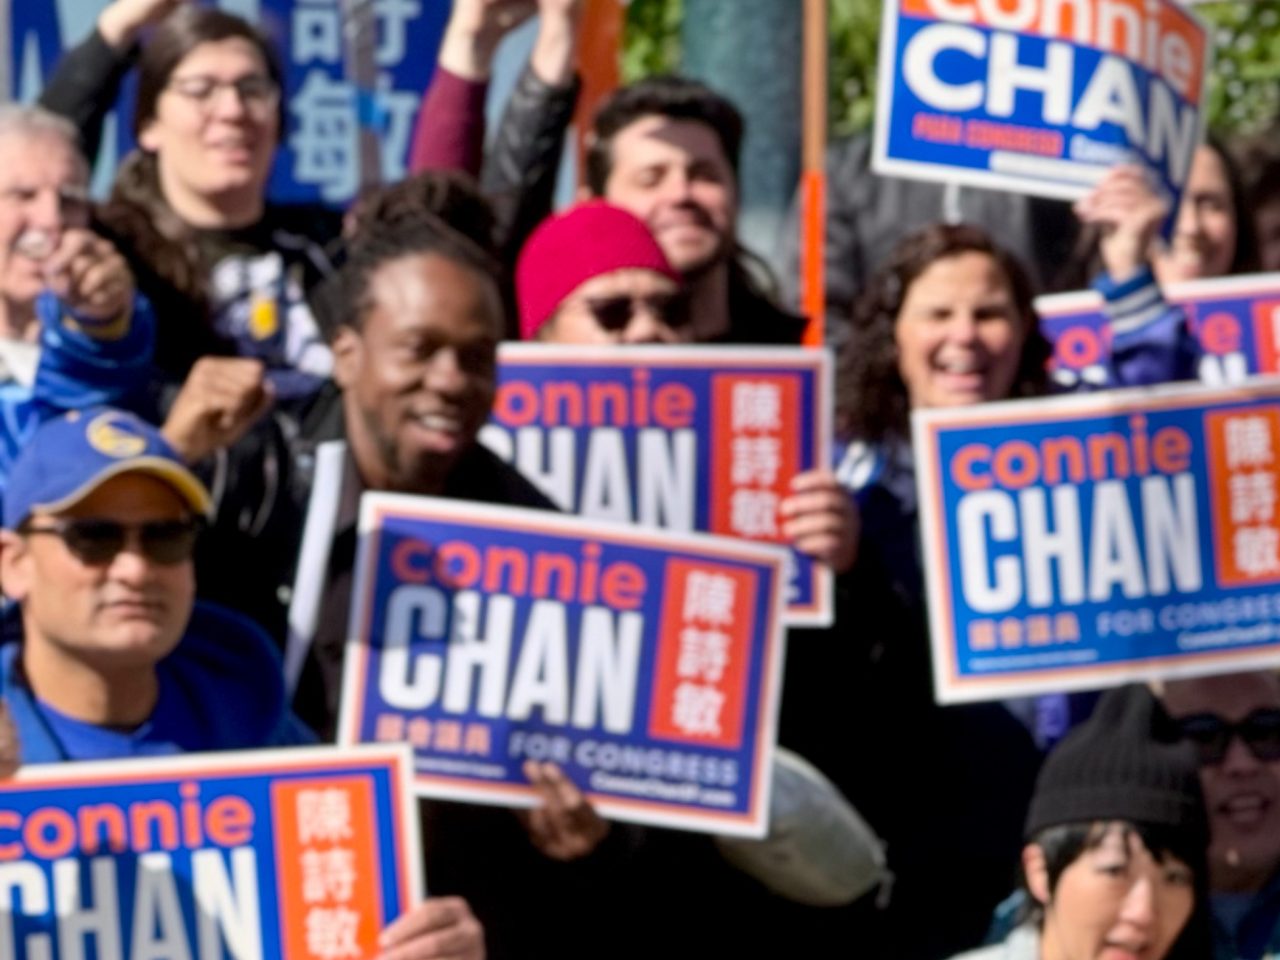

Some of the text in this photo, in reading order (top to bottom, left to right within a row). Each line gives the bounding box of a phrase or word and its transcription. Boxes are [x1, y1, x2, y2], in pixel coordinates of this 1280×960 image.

[902, 20, 1198, 188] CHAN
[492, 367, 696, 428] onnie
[951, 414, 1192, 491] connie
[391, 540, 647, 610] connie
[957, 473, 1203, 613] CHAN
[379, 584, 643, 735] CHAN
[1096, 608, 1156, 638] FOR
[508, 730, 739, 787] FOR CONGRESS
